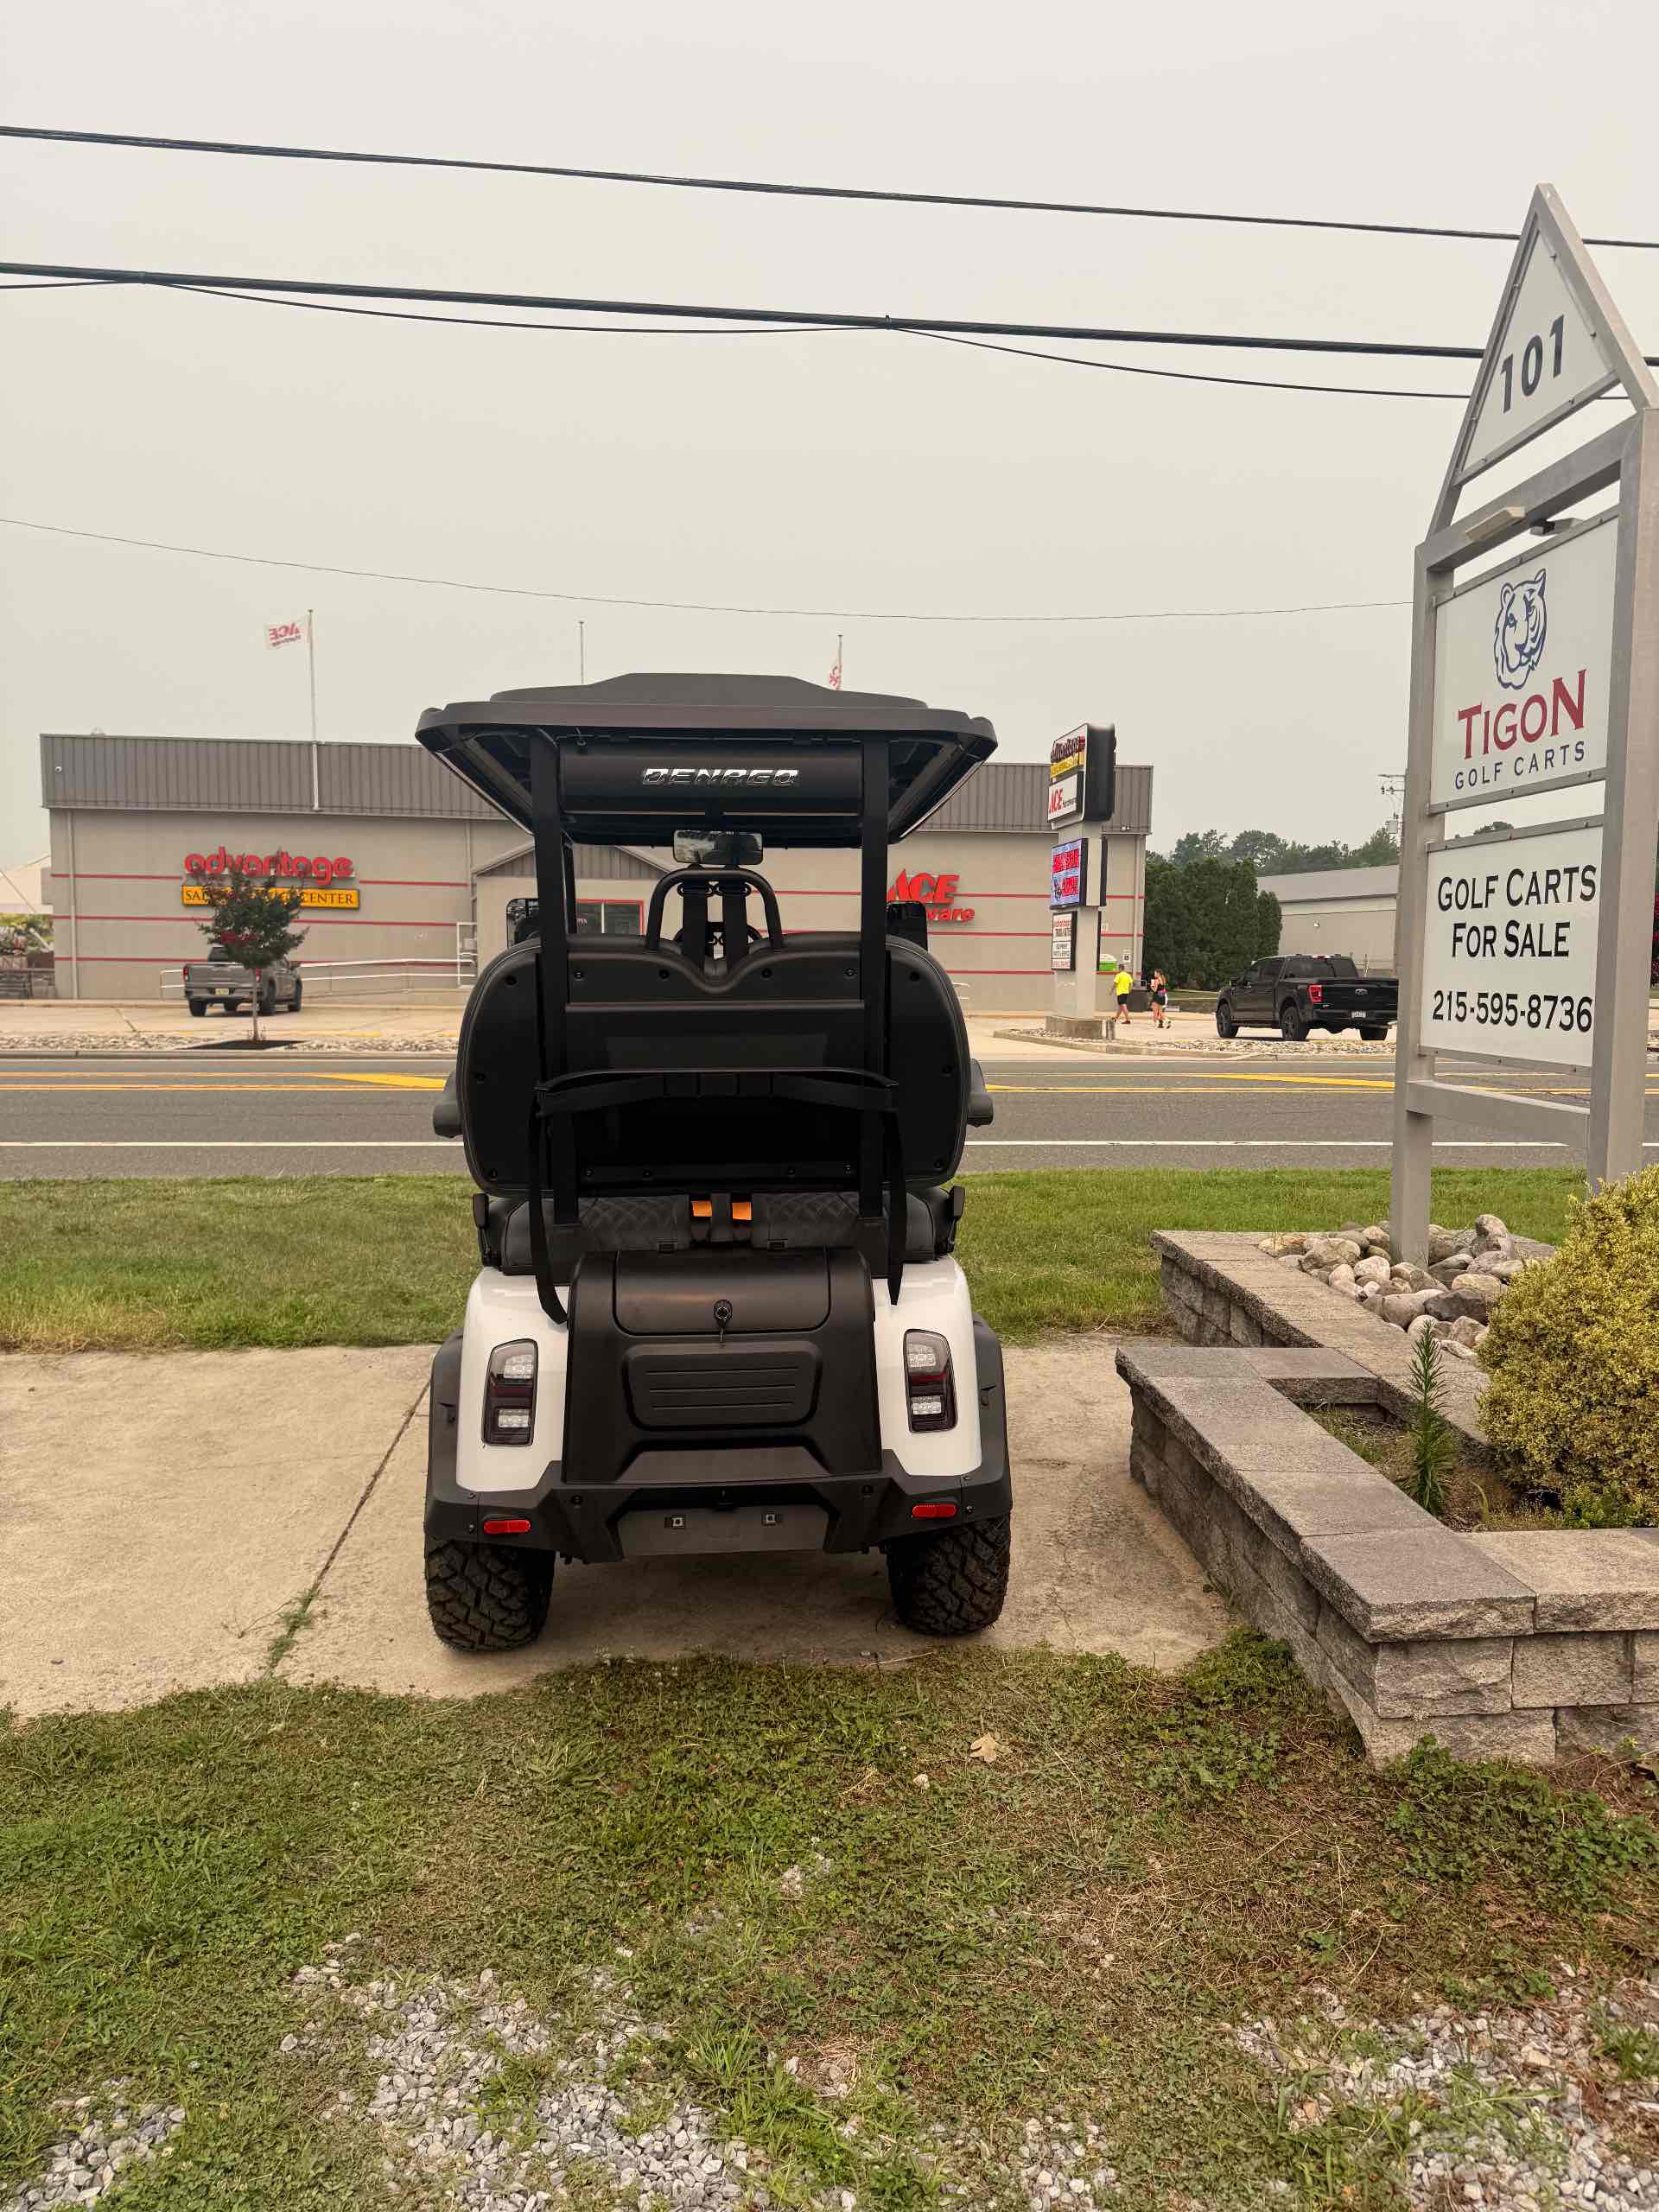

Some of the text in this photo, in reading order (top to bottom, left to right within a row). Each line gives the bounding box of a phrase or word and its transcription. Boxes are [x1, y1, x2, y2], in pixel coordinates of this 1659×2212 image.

[1500, 314, 1565, 414] 101
[1458, 669, 1586, 760] TIGON
[641, 767, 800, 786] DENAGO
[1455, 741, 1586, 790] GOLF CARTS
[1050, 787, 1064, 814] ACE
[184, 845, 354, 886] advantage
[185, 890, 208, 902] SAL
[887, 869, 960, 904] ACE
[1438, 864, 1597, 912] GOLF CARTS
[926, 907, 976, 923] ware
[1452, 919, 1571, 957] FOR SALE
[1432, 990, 1593, 1033] 215-595-8736
